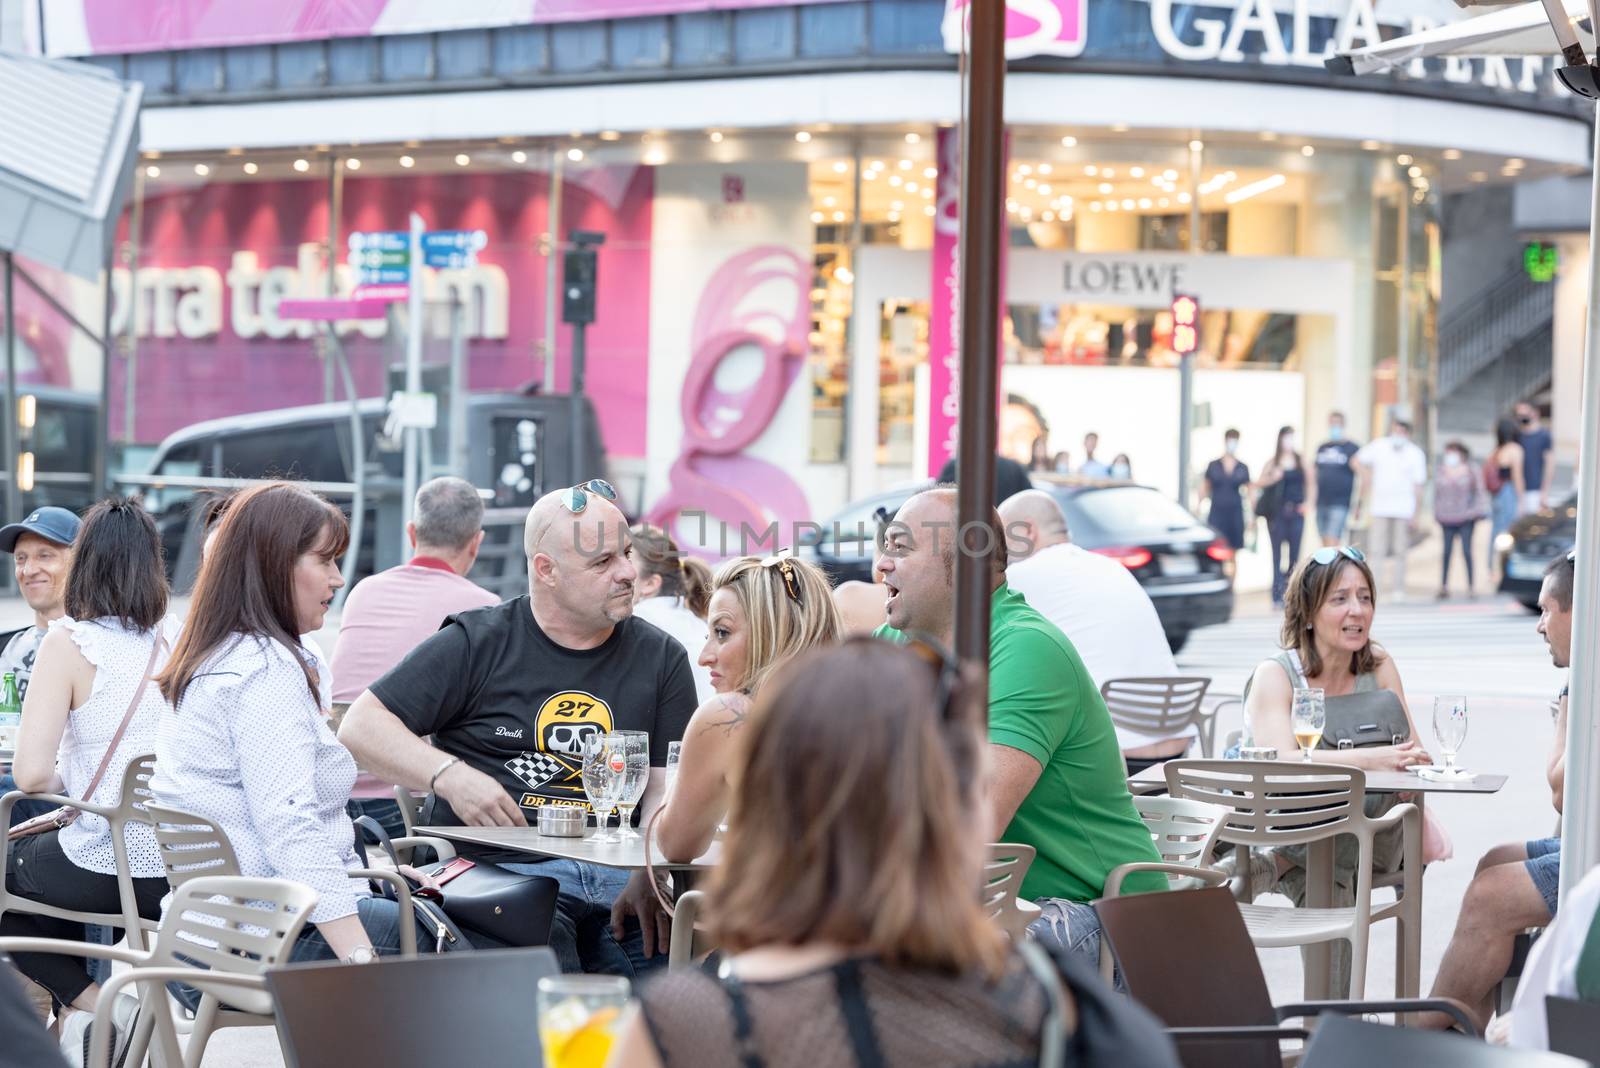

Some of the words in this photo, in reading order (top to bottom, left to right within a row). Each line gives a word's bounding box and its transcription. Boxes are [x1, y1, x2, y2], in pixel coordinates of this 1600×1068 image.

[1062, 260, 1187, 294] LOEWE
[554, 700, 595, 718] 27
[495, 726, 523, 739] Death
